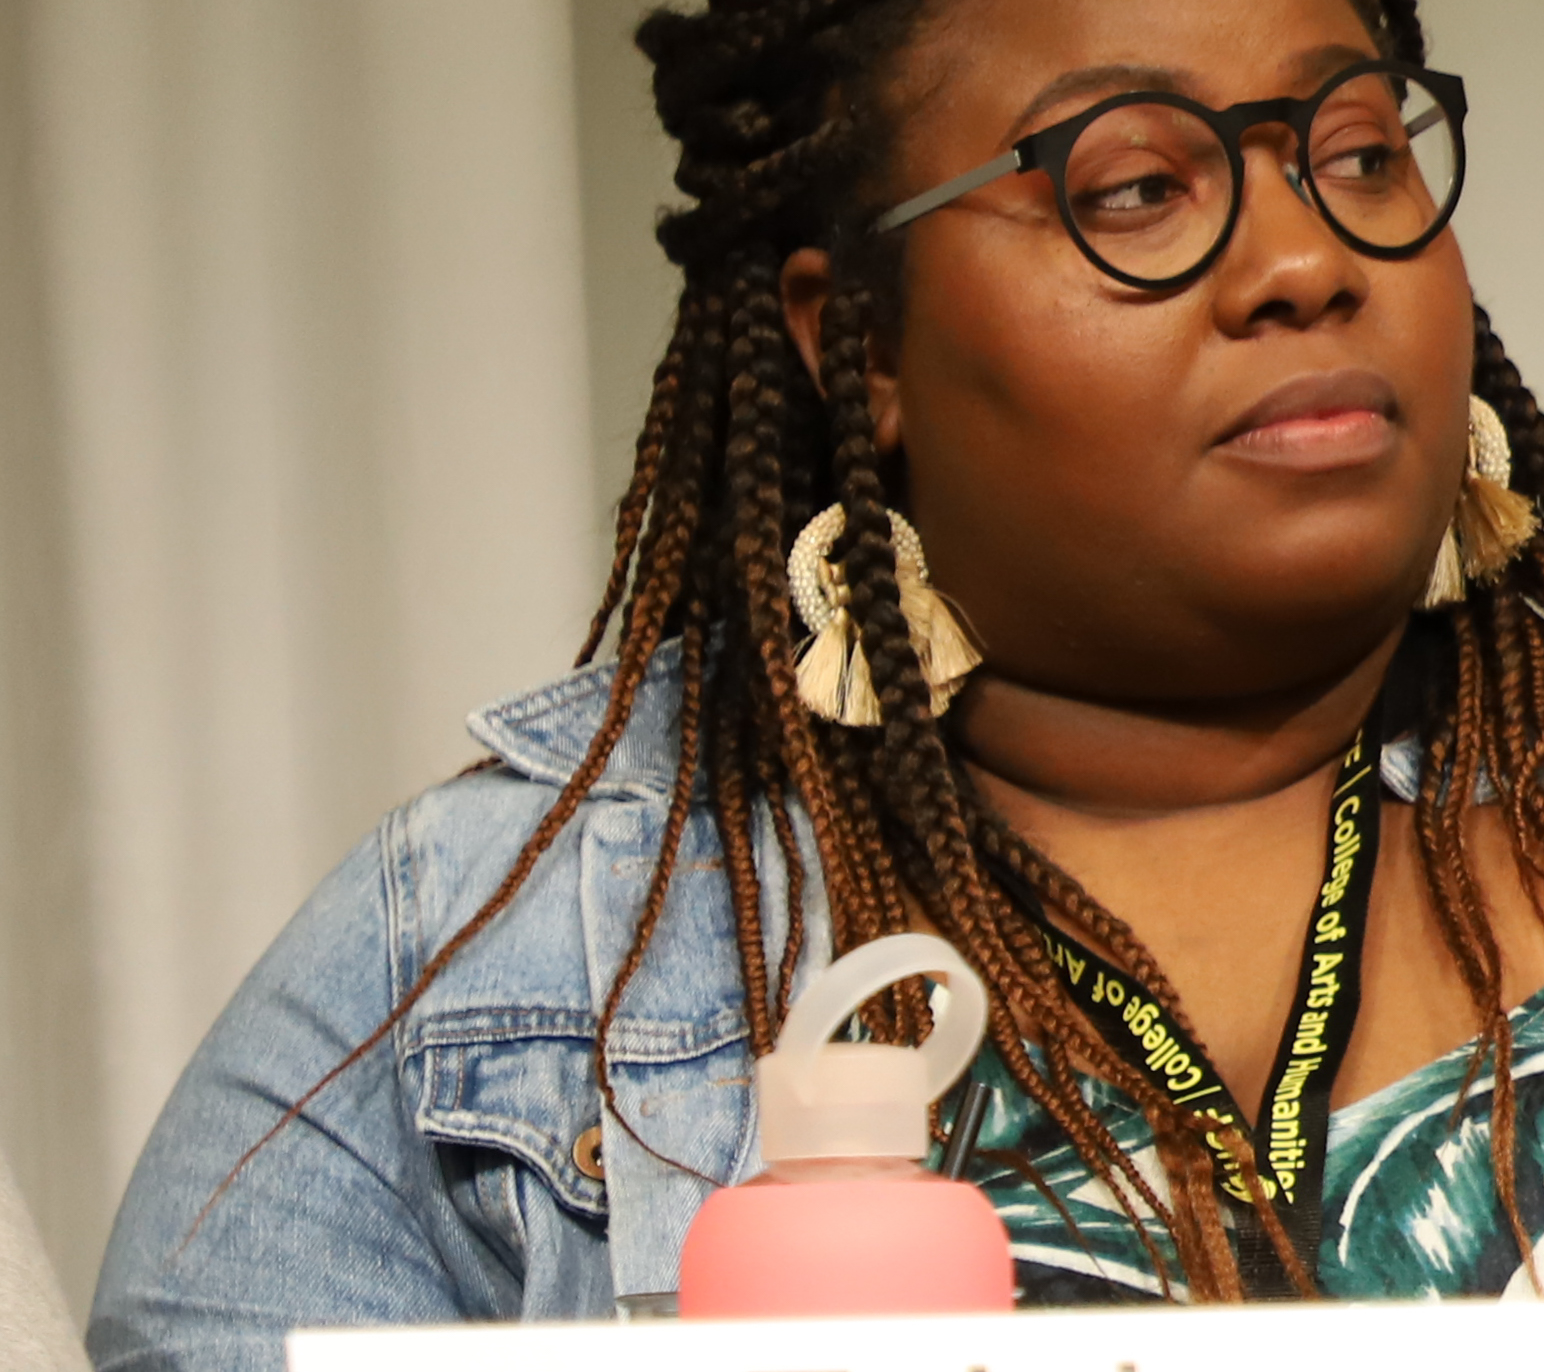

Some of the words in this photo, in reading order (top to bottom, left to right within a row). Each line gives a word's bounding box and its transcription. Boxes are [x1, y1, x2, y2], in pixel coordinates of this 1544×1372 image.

[1321, 795, 1361, 908] College
[1314, 911, 1347, 944] of
[1091, 971, 1125, 1007] of
[1307, 952, 1344, 1008] Arts
[1122, 996, 1203, 1091] College
[1292, 1011, 1329, 1055] and
[1268, 1056, 1323, 1204] Humanitie
